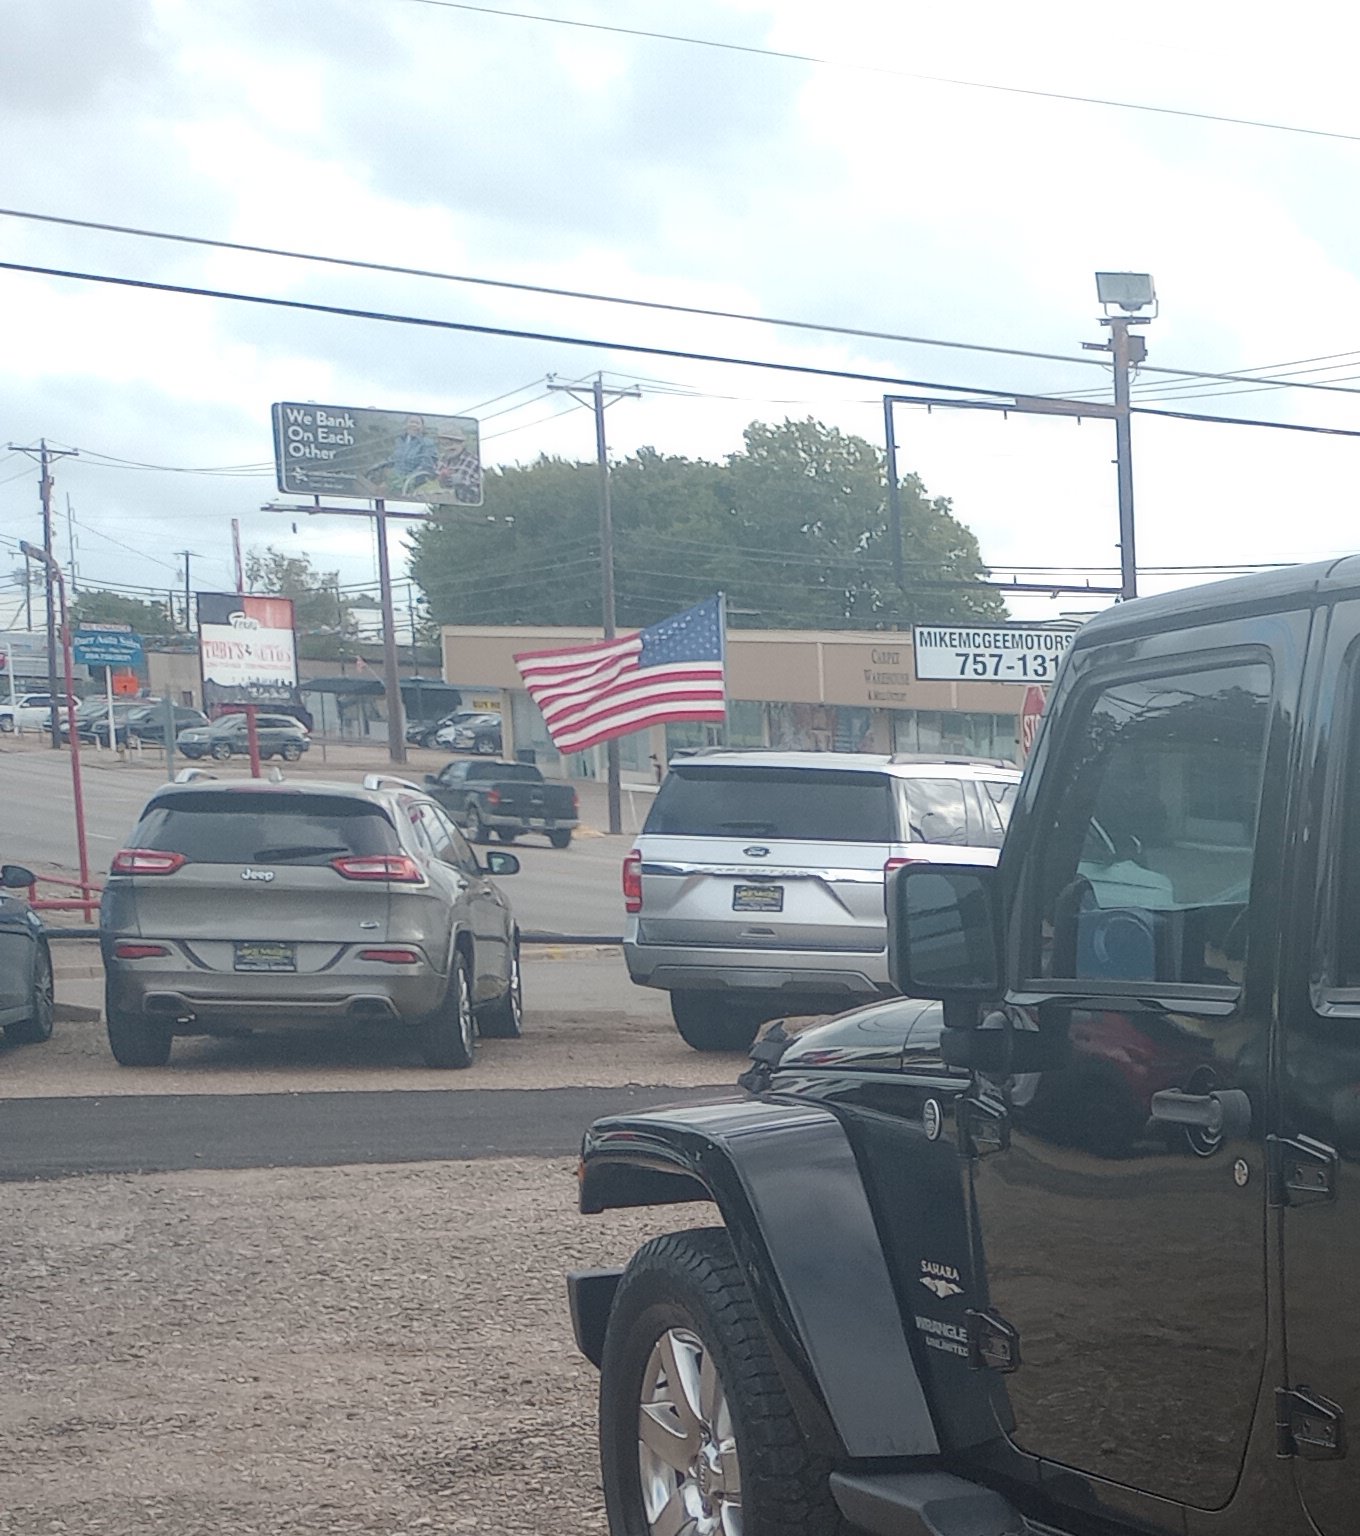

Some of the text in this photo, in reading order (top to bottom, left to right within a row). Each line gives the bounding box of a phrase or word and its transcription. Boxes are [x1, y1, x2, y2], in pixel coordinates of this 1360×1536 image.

[287, 408, 354, 428] We Bank
[288, 426, 354, 445] On Each
[289, 442, 336, 459] Other
[919, 630, 1072, 651] MIKEMCGEEMOTORS
[1024, 714, 1041, 748] ST
[241, 868, 275, 882] Jeep
[921, 1260, 960, 1281] SAHARA
[915, 1315, 968, 1343] WRANGLE
